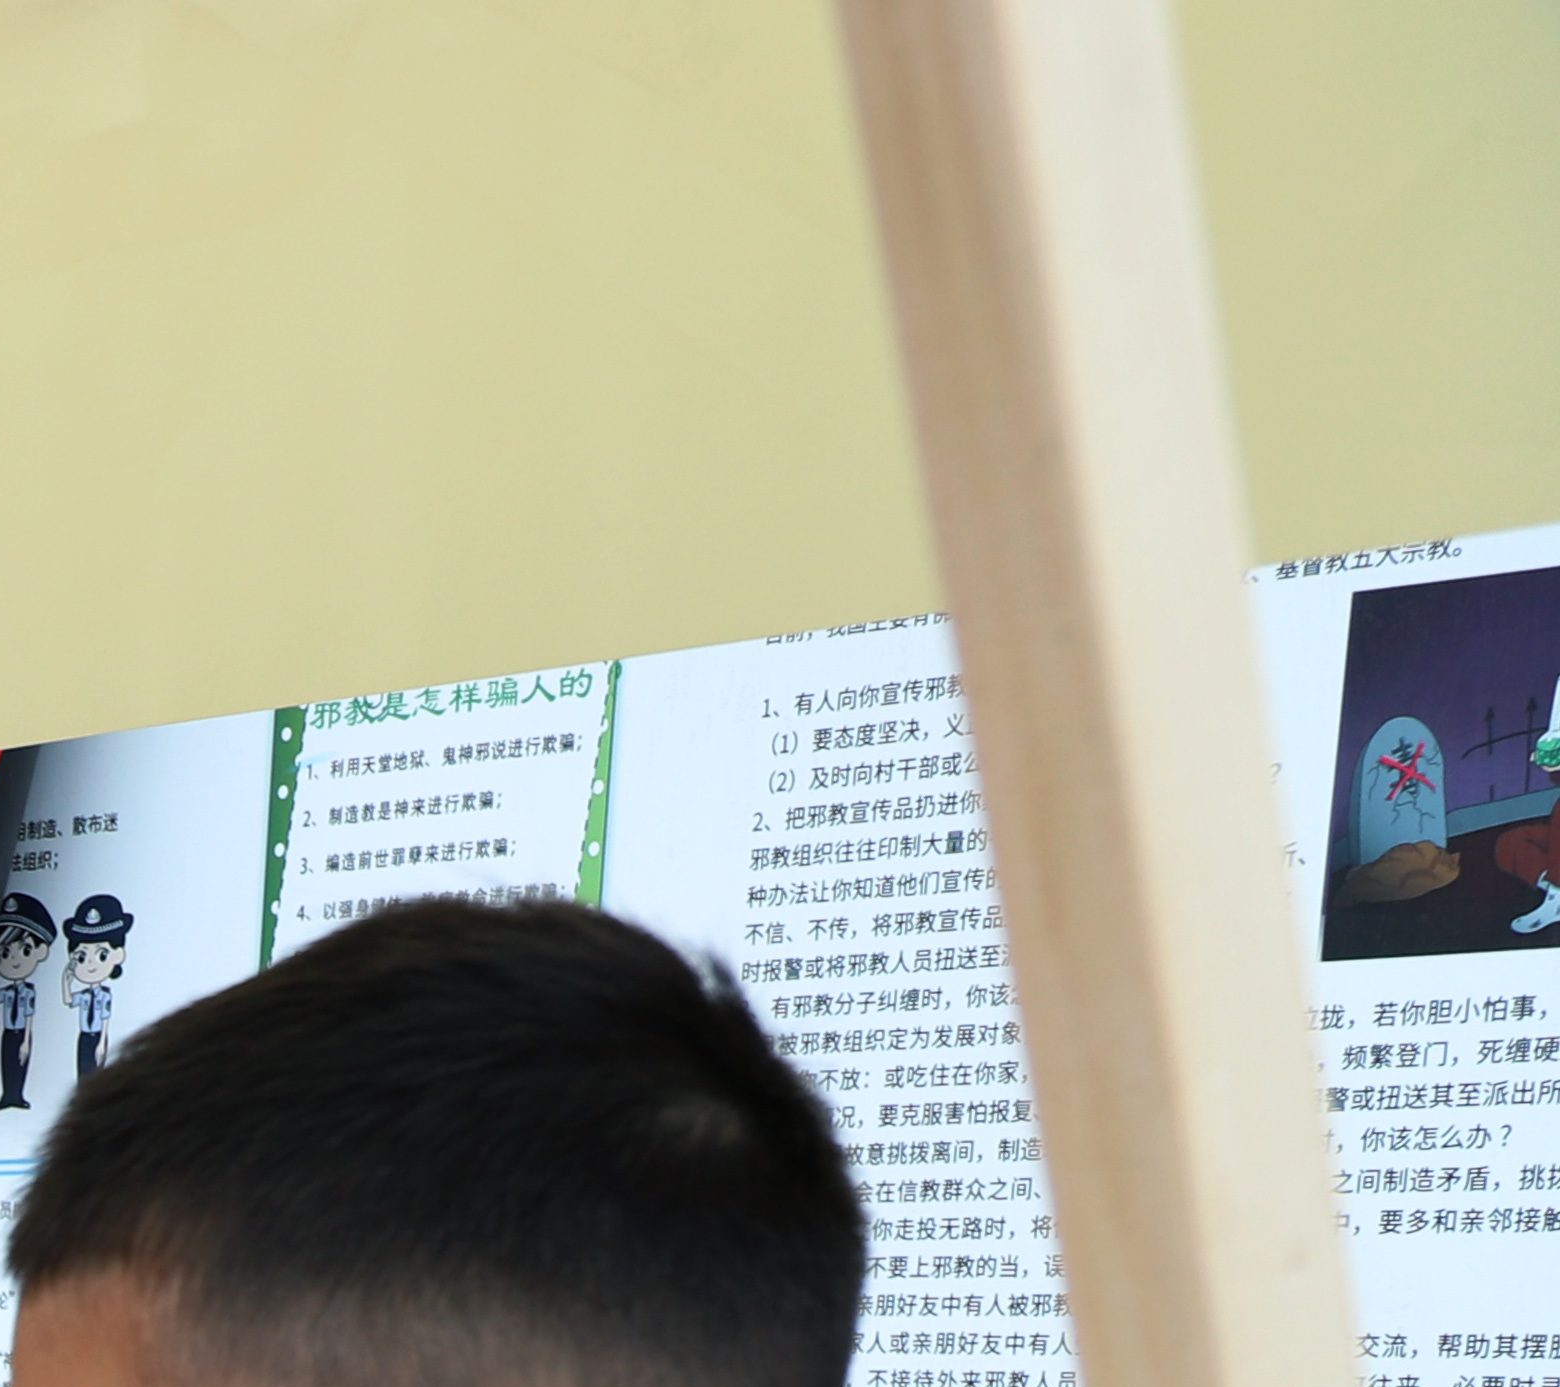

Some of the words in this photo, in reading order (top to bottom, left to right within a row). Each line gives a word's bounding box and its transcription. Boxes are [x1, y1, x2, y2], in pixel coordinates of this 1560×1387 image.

[752, 790, 987, 832] 2、把邪教宣传品扔进你
[767, 1021, 1021, 1057] 被邪教组织定为发展对象
[1316, 1080, 1560, 1112] 警或扭送其至派出所
[827, 1099, 1039, 1128] 况，要克服害怕报复、
[861, 1215, 1058, 1241] 你走投无路时，将
[851, 1332, 1079, 1355] 家人或亲朋好友中有人
